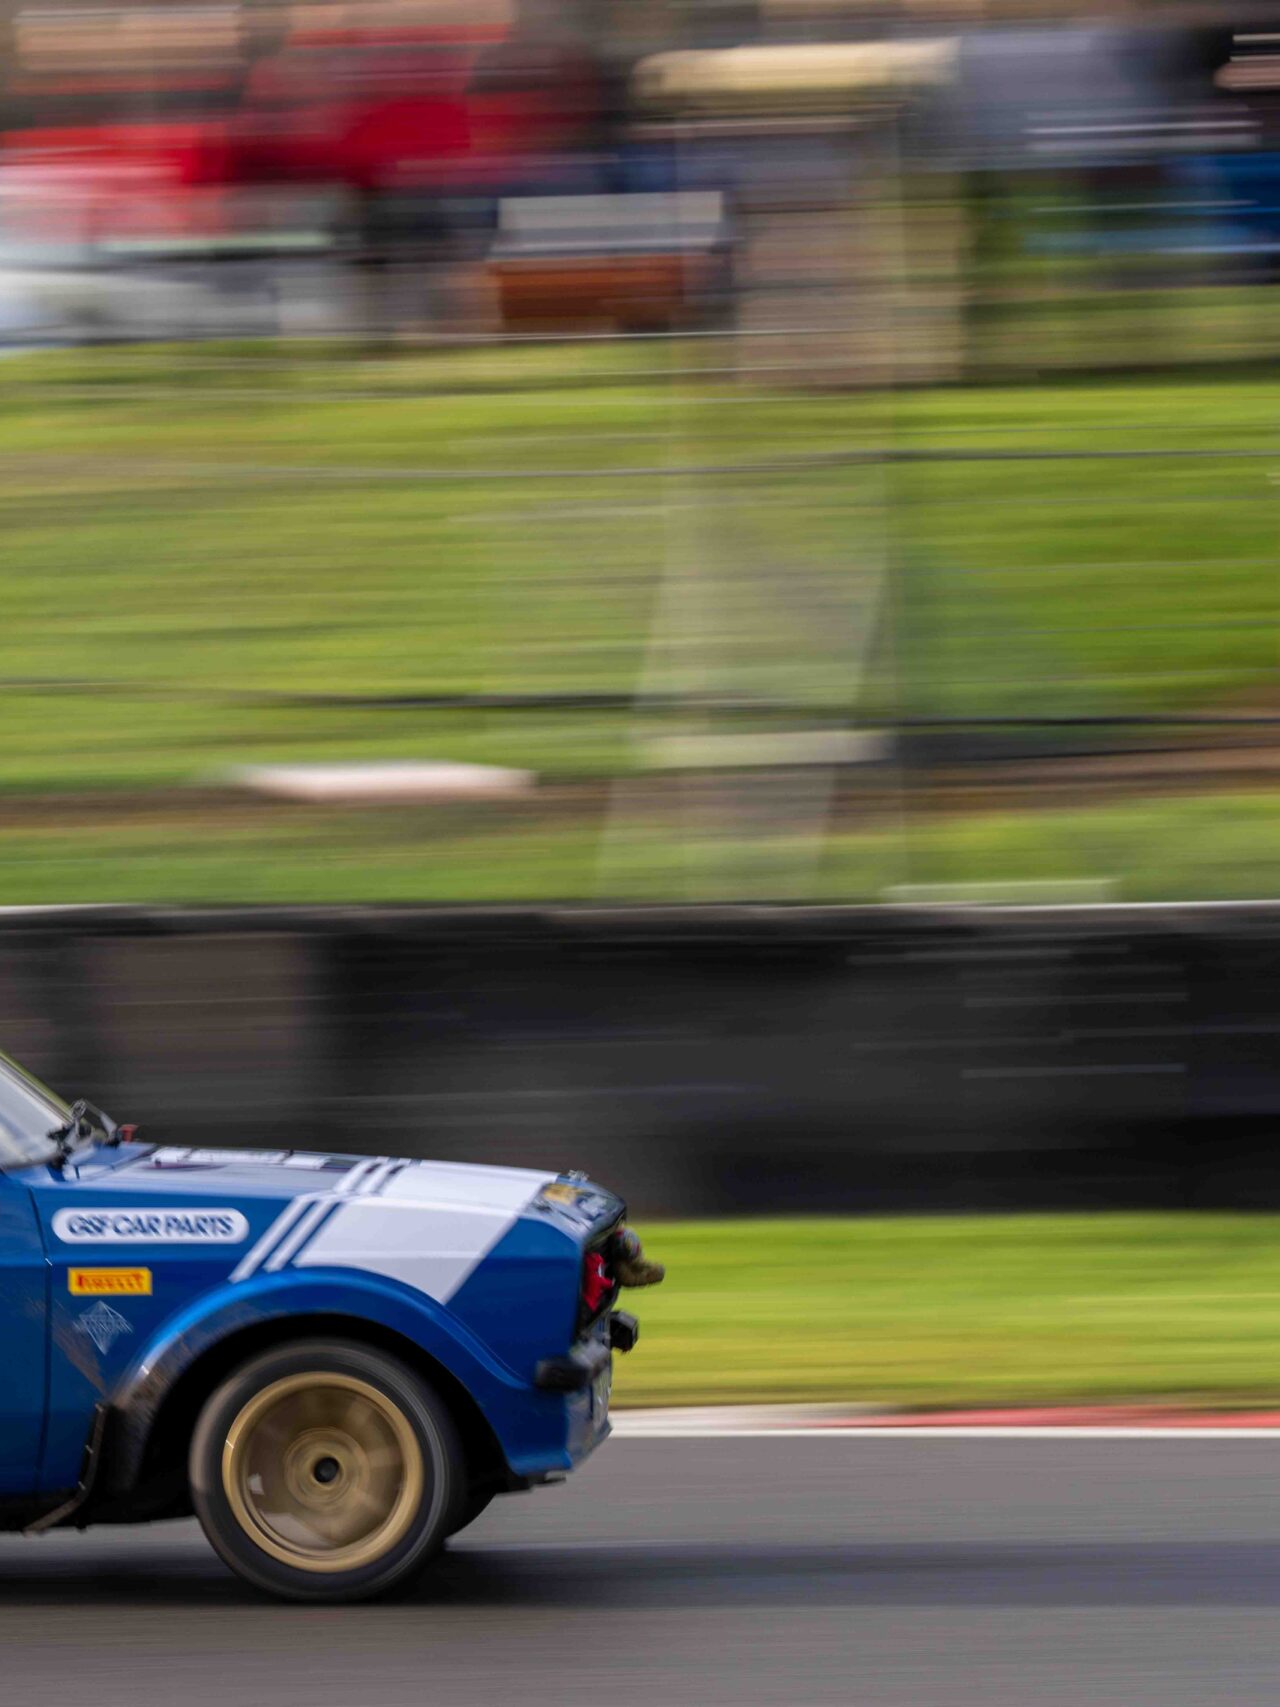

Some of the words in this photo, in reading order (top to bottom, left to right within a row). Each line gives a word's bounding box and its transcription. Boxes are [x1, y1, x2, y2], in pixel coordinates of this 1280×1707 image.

[67, 1213, 108, 1236] GSF
[112, 1213, 162, 1236] CAR
[165, 1213, 235, 1236] PARTS
